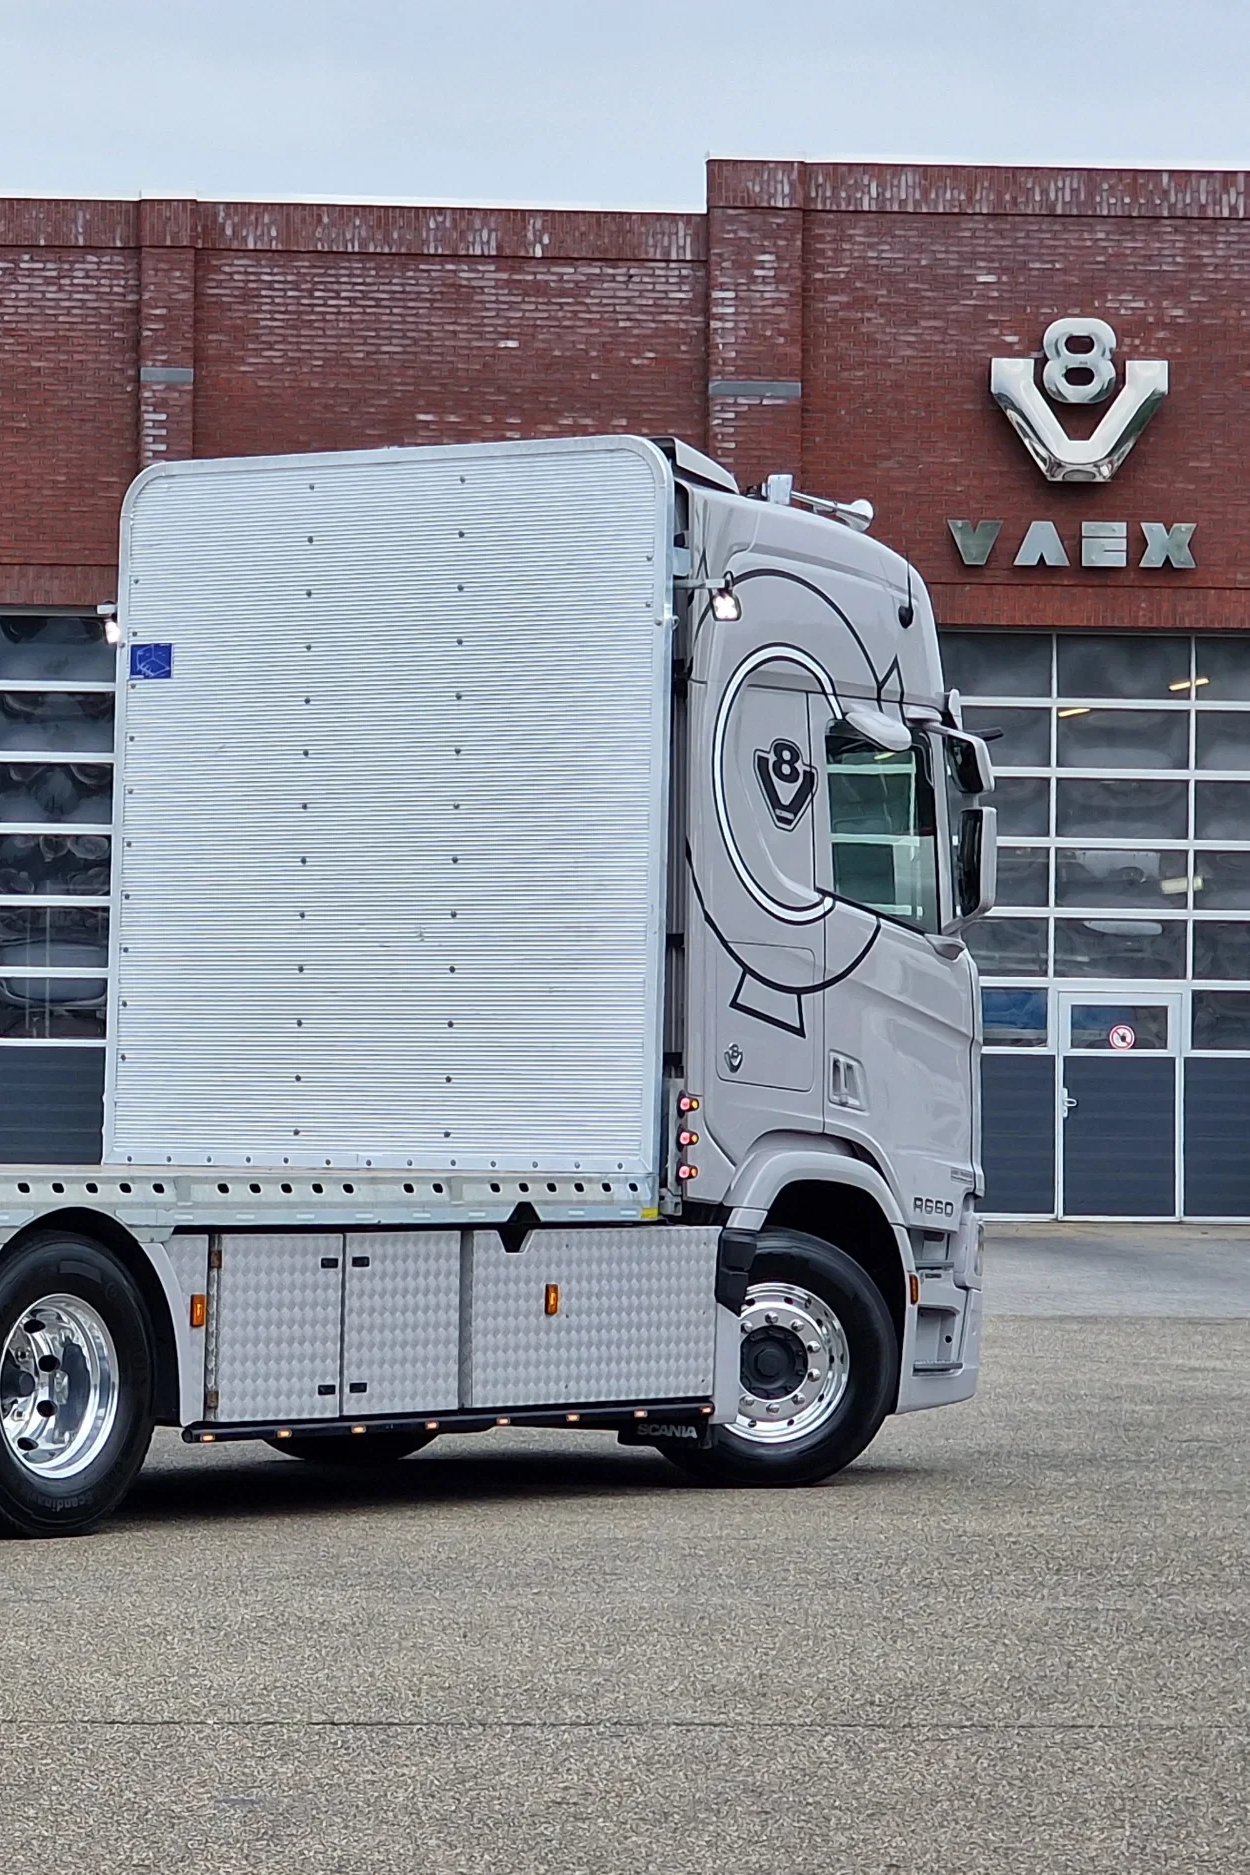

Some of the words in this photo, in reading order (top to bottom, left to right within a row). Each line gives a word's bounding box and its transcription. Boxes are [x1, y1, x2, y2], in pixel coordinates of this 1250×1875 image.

[947, 519, 1198, 568] VAEX
[913, 1197, 954, 1217] R660
[637, 1423, 697, 1439] SCANIA
